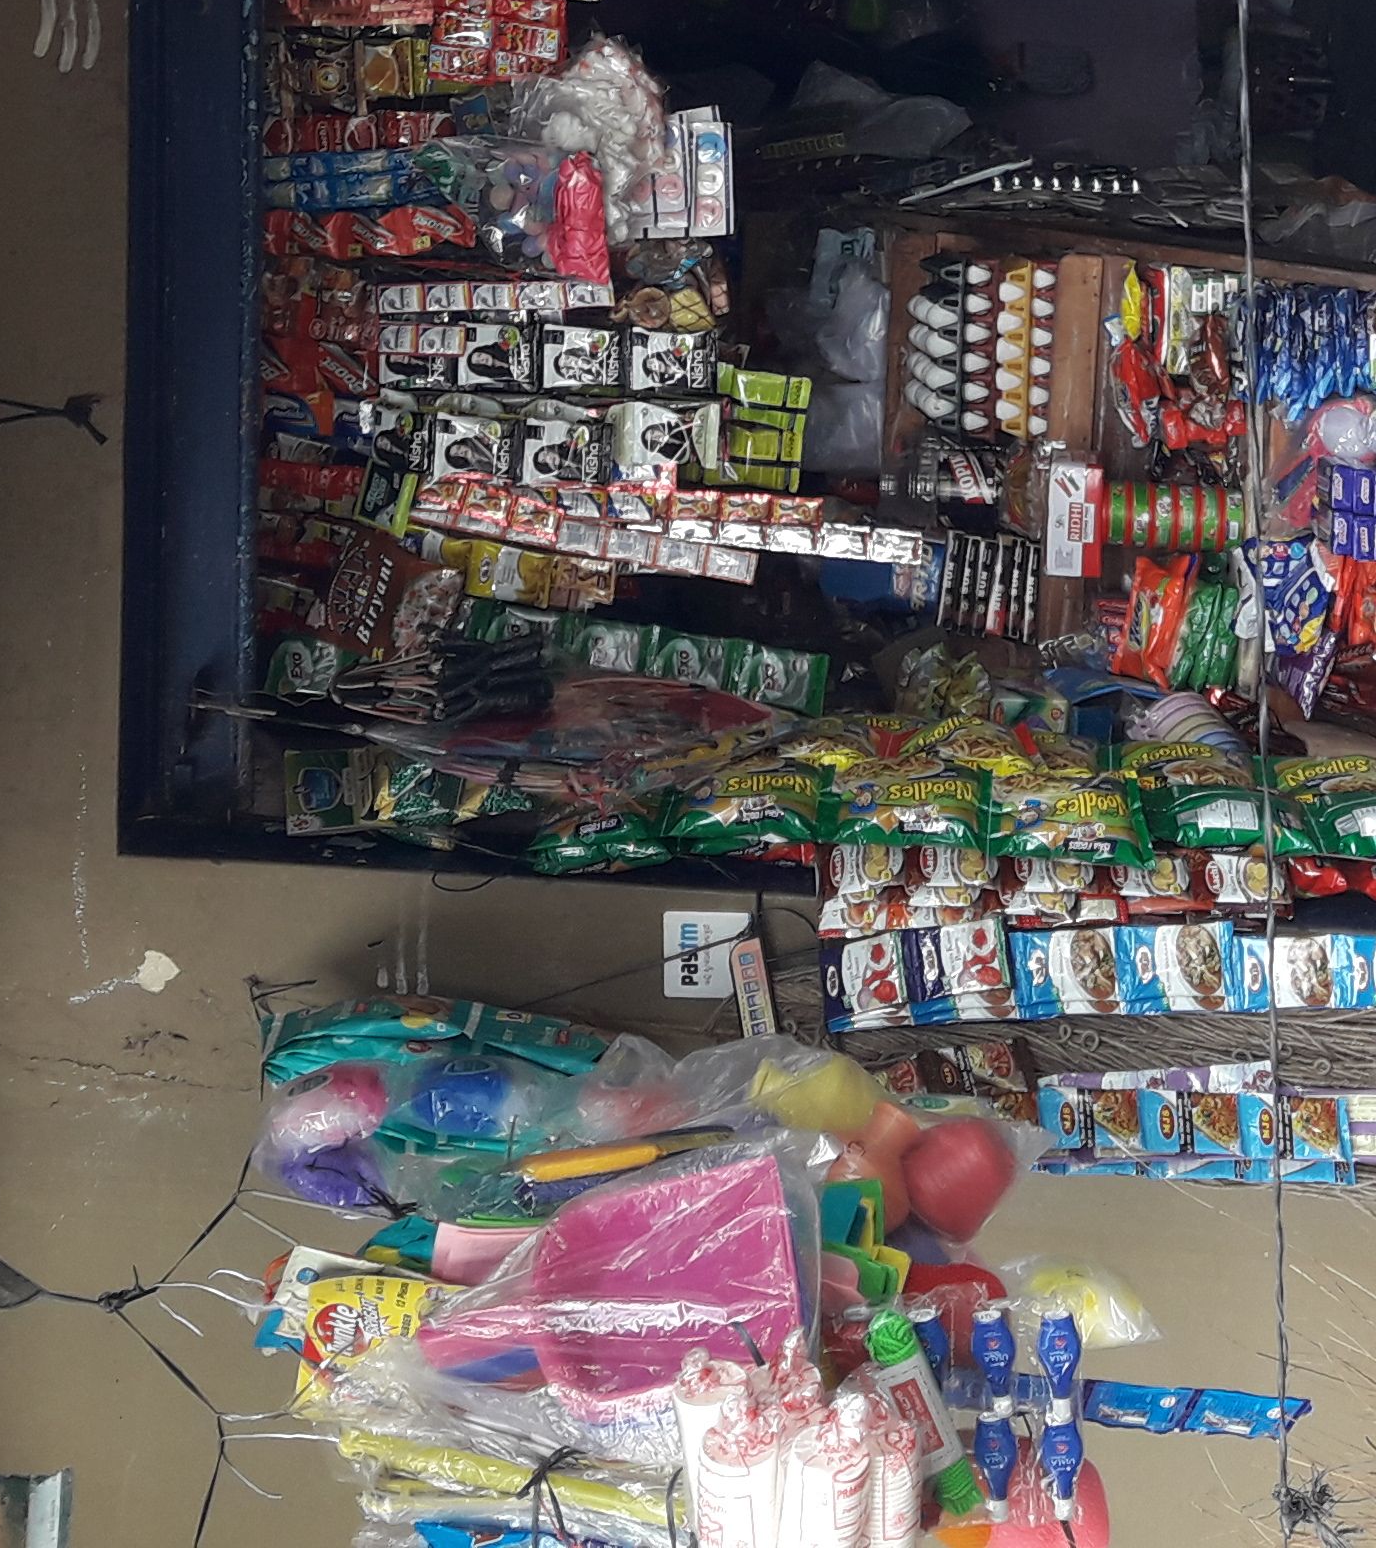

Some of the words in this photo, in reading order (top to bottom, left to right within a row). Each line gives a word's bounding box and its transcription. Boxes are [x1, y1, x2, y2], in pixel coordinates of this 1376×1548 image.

[1069, 502, 1082, 541] RIDHI
[355, 552, 394, 644] Biryani
[726, 775, 813, 795] Noodles
[1285, 757, 1370, 787] Noodles
[886, 782, 975, 800] Noodles
[1162, 1109, 1171, 1134] MJS
[1262, 1113, 1270, 1139] MJS
[324, 1304, 359, 1356] Twinkle
